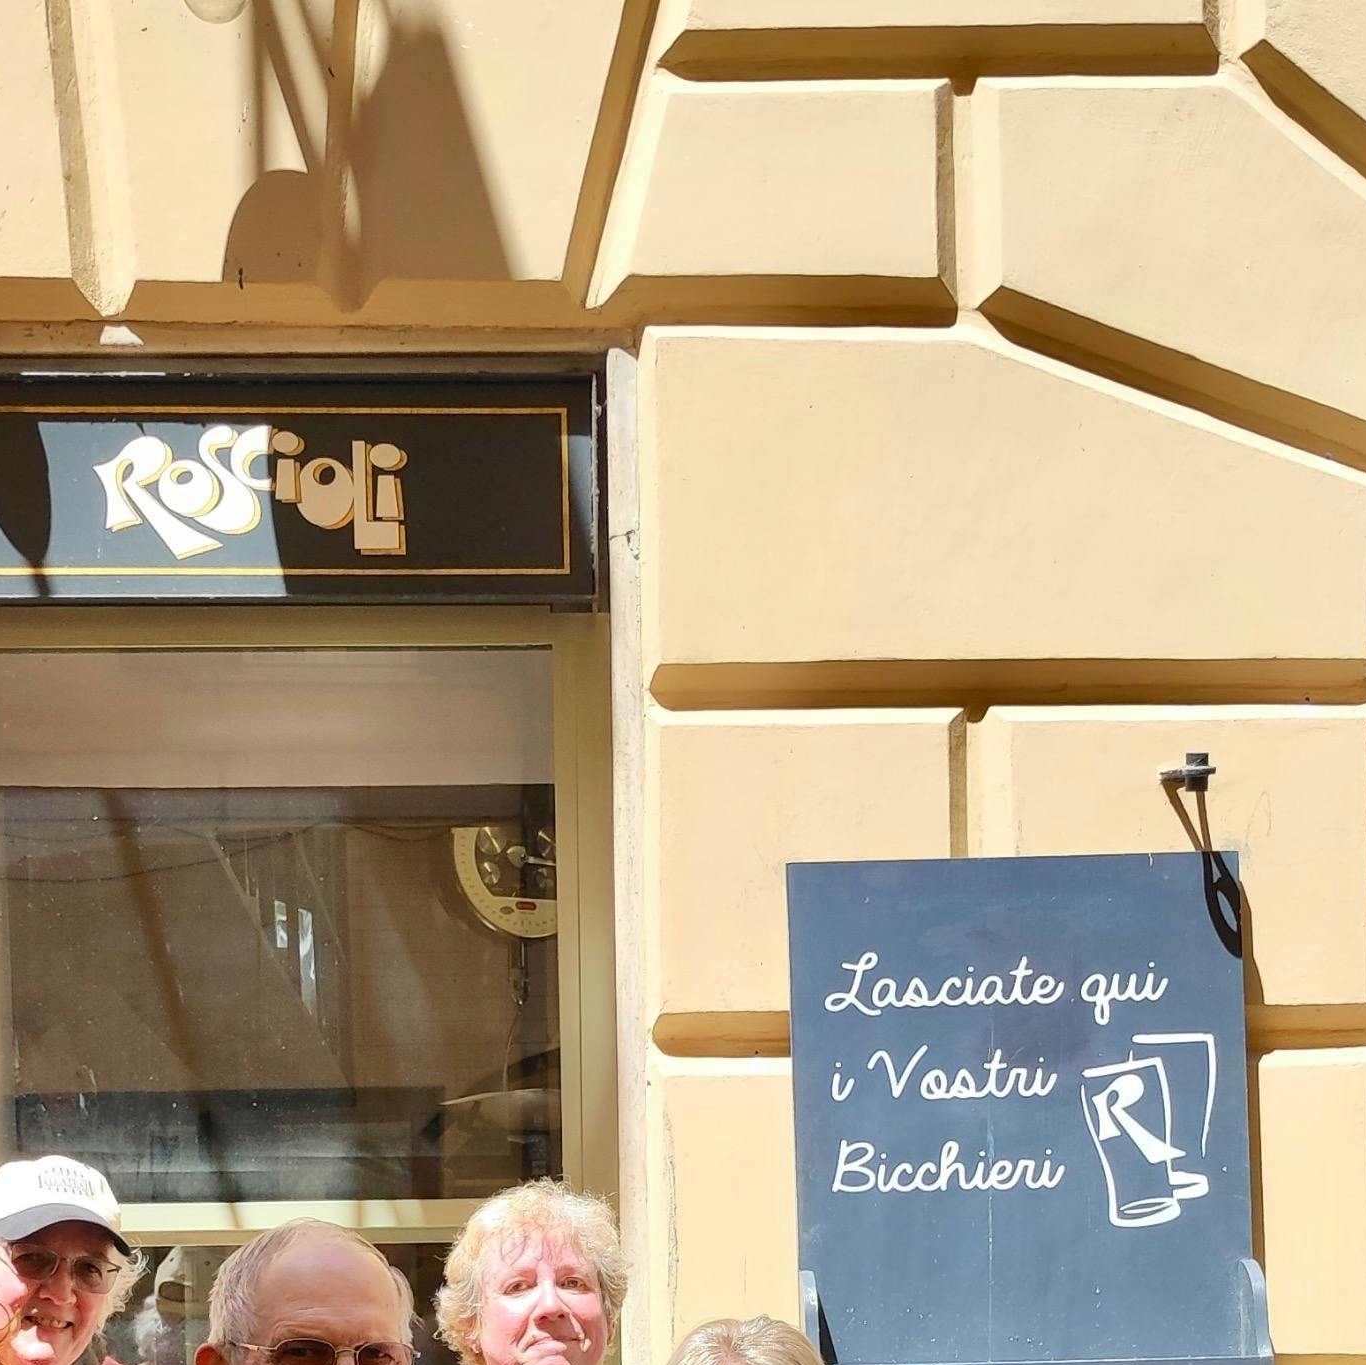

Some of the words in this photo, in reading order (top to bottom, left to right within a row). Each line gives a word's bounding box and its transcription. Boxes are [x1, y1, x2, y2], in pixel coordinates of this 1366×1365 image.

[824, 952, 1064, 1016] Lasciate
[1079, 962, 1169, 1025] qui
[831, 1060, 856, 1101] i
[867, 1044, 1058, 1100] Vostri
[831, 1139, 1065, 1194] Bicchieri
